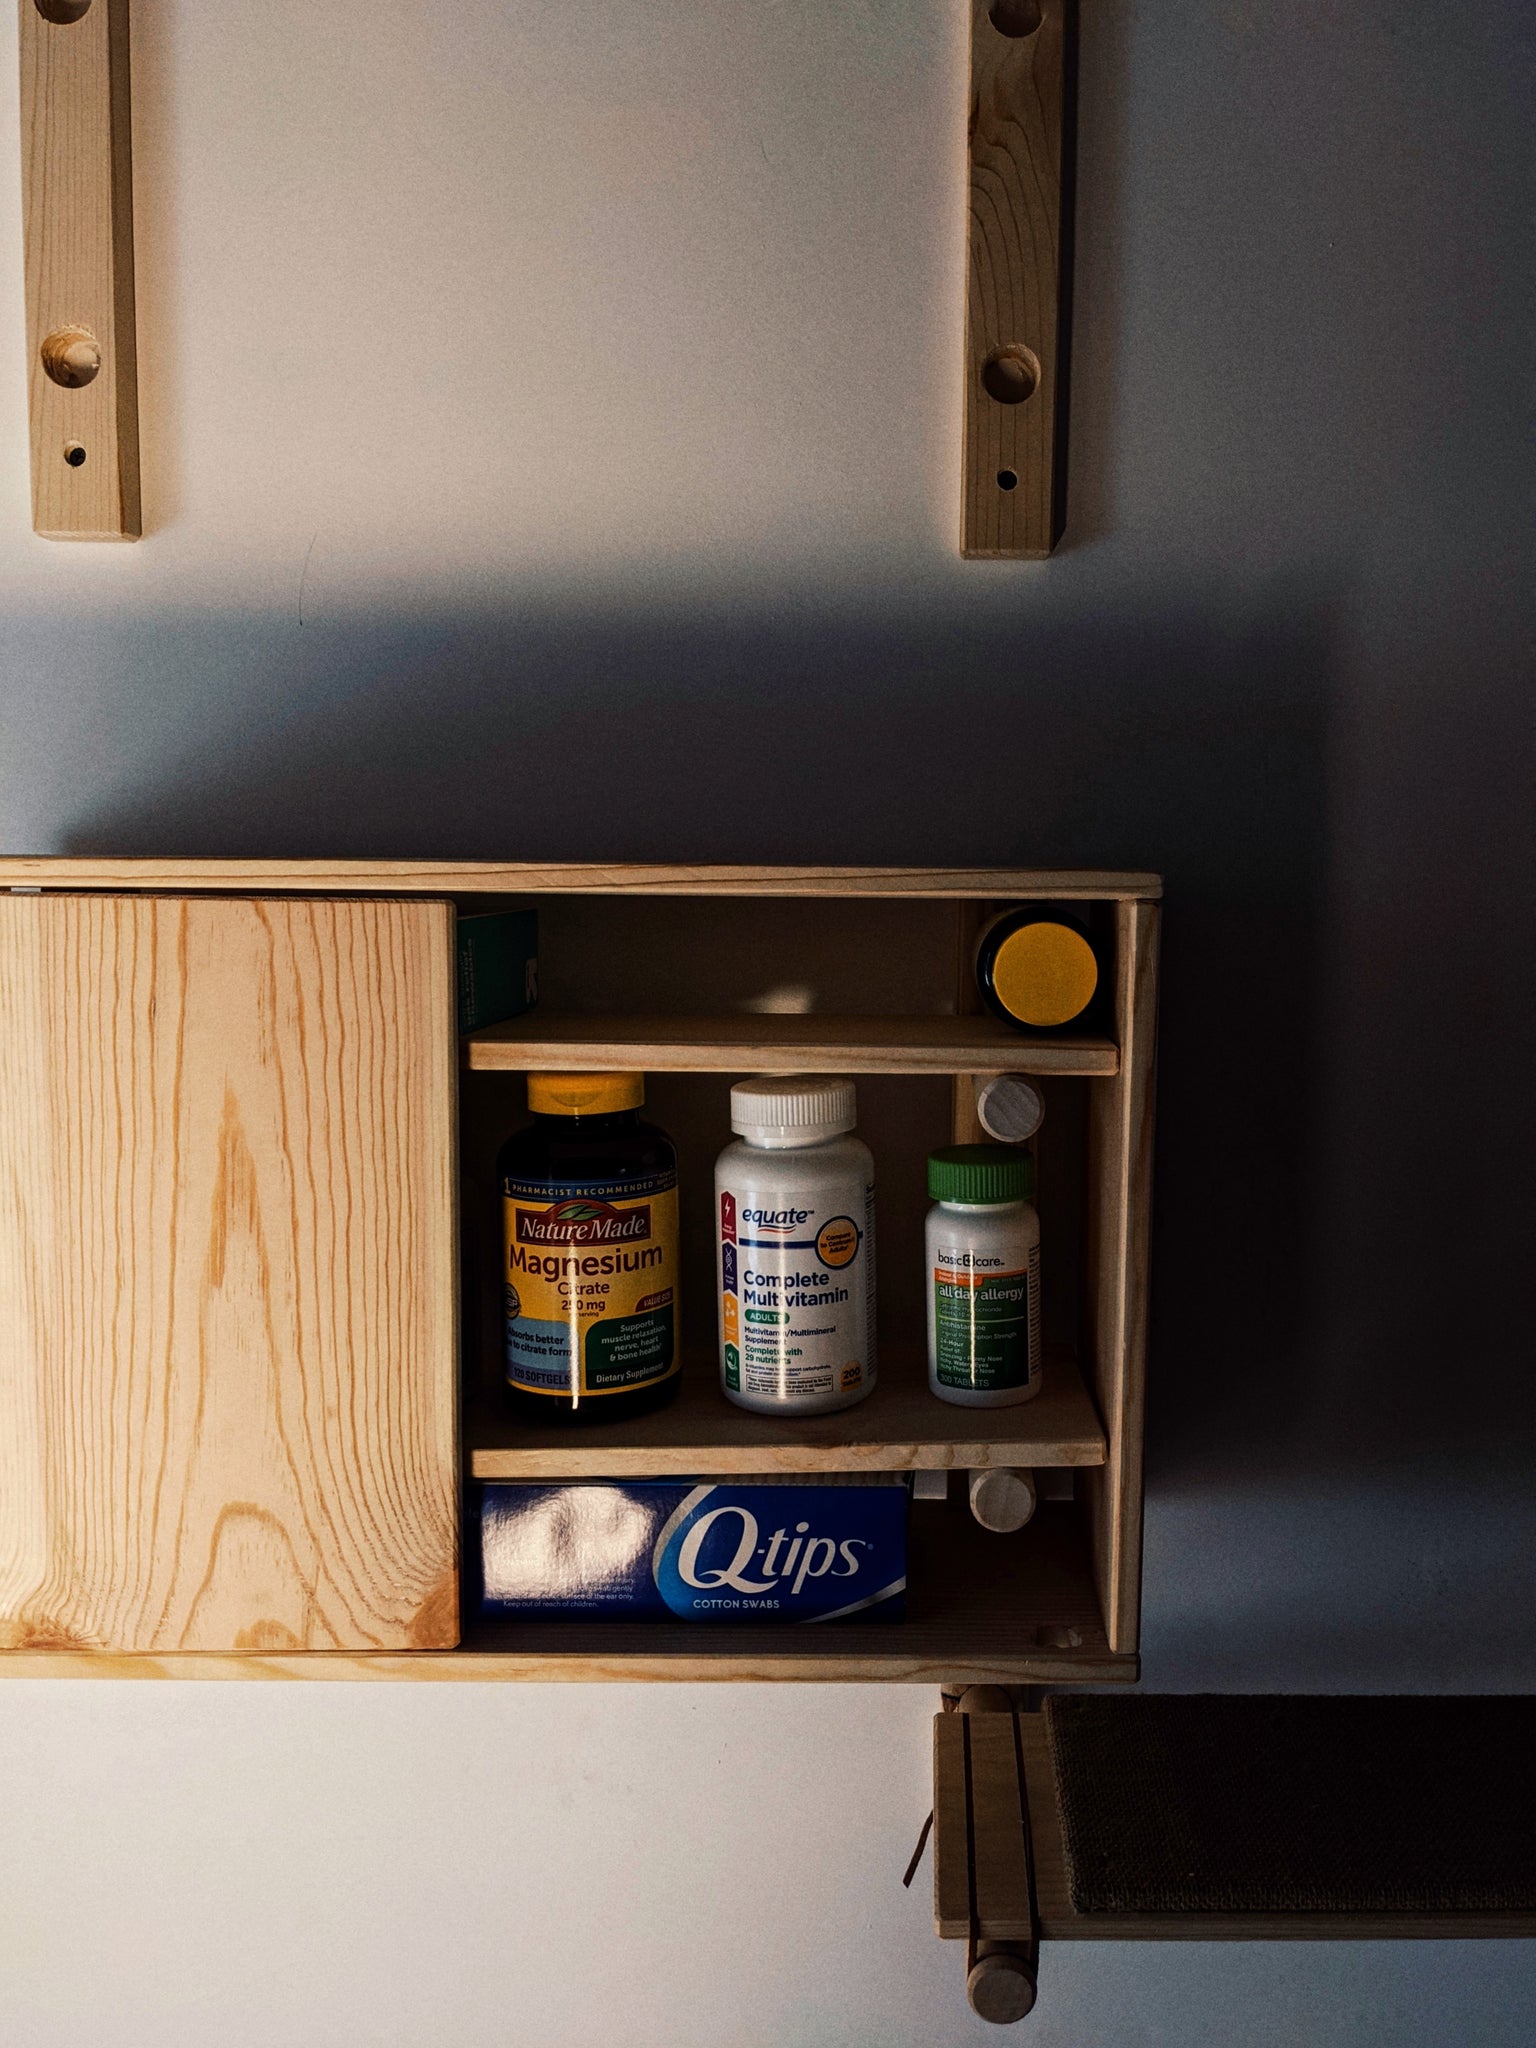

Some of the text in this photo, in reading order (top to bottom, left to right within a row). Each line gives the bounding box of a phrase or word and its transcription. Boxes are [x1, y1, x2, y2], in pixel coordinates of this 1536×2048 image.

[512, 1184, 571, 1196] PHARMACIST
[576, 1181, 654, 1196] RECOMMENDED
[742, 1208, 808, 1227] equate
[521, 1215, 645, 1240] Nature Made
[510, 1244, 663, 1282] Magnesium
[975, 1256, 1001, 1266] care
[744, 1270, 829, 1290] Complete
[744, 1287, 848, 1307] Multvitamin
[939, 1285, 953, 1298] all
[980, 1286, 1024, 1302] allergy
[586, 1301, 605, 1311] mg
[620, 1319, 654, 1333] Supports
[744, 1326, 836, 1337] Multivitam/Multimineral
[940, 1319, 986, 1331] Antihistane
[536, 1334, 564, 1345] better
[601, 1334, 631, 1345] muscle
[640, 1336, 659, 1347] heart
[745, 1335, 787, 1345] Supplemet
[513, 1340, 520, 1350] to
[521, 1344, 547, 1355] citrate
[609, 1353, 616, 1362] &
[617, 1350, 638, 1361] bone
[745, 1353, 791, 1365] 29 nutriets
[513, 1367, 571, 1385] 120 SOFTGELS
[596, 1361, 664, 1383] Dietary Supplement
[843, 1366, 860, 1379] 200
[677, 1506, 866, 1595] Q-tips
[503, 1600, 521, 1608] Keep
[570, 1600, 599, 1608] children.
[693, 1599, 780, 1609] COTTON SWABS
